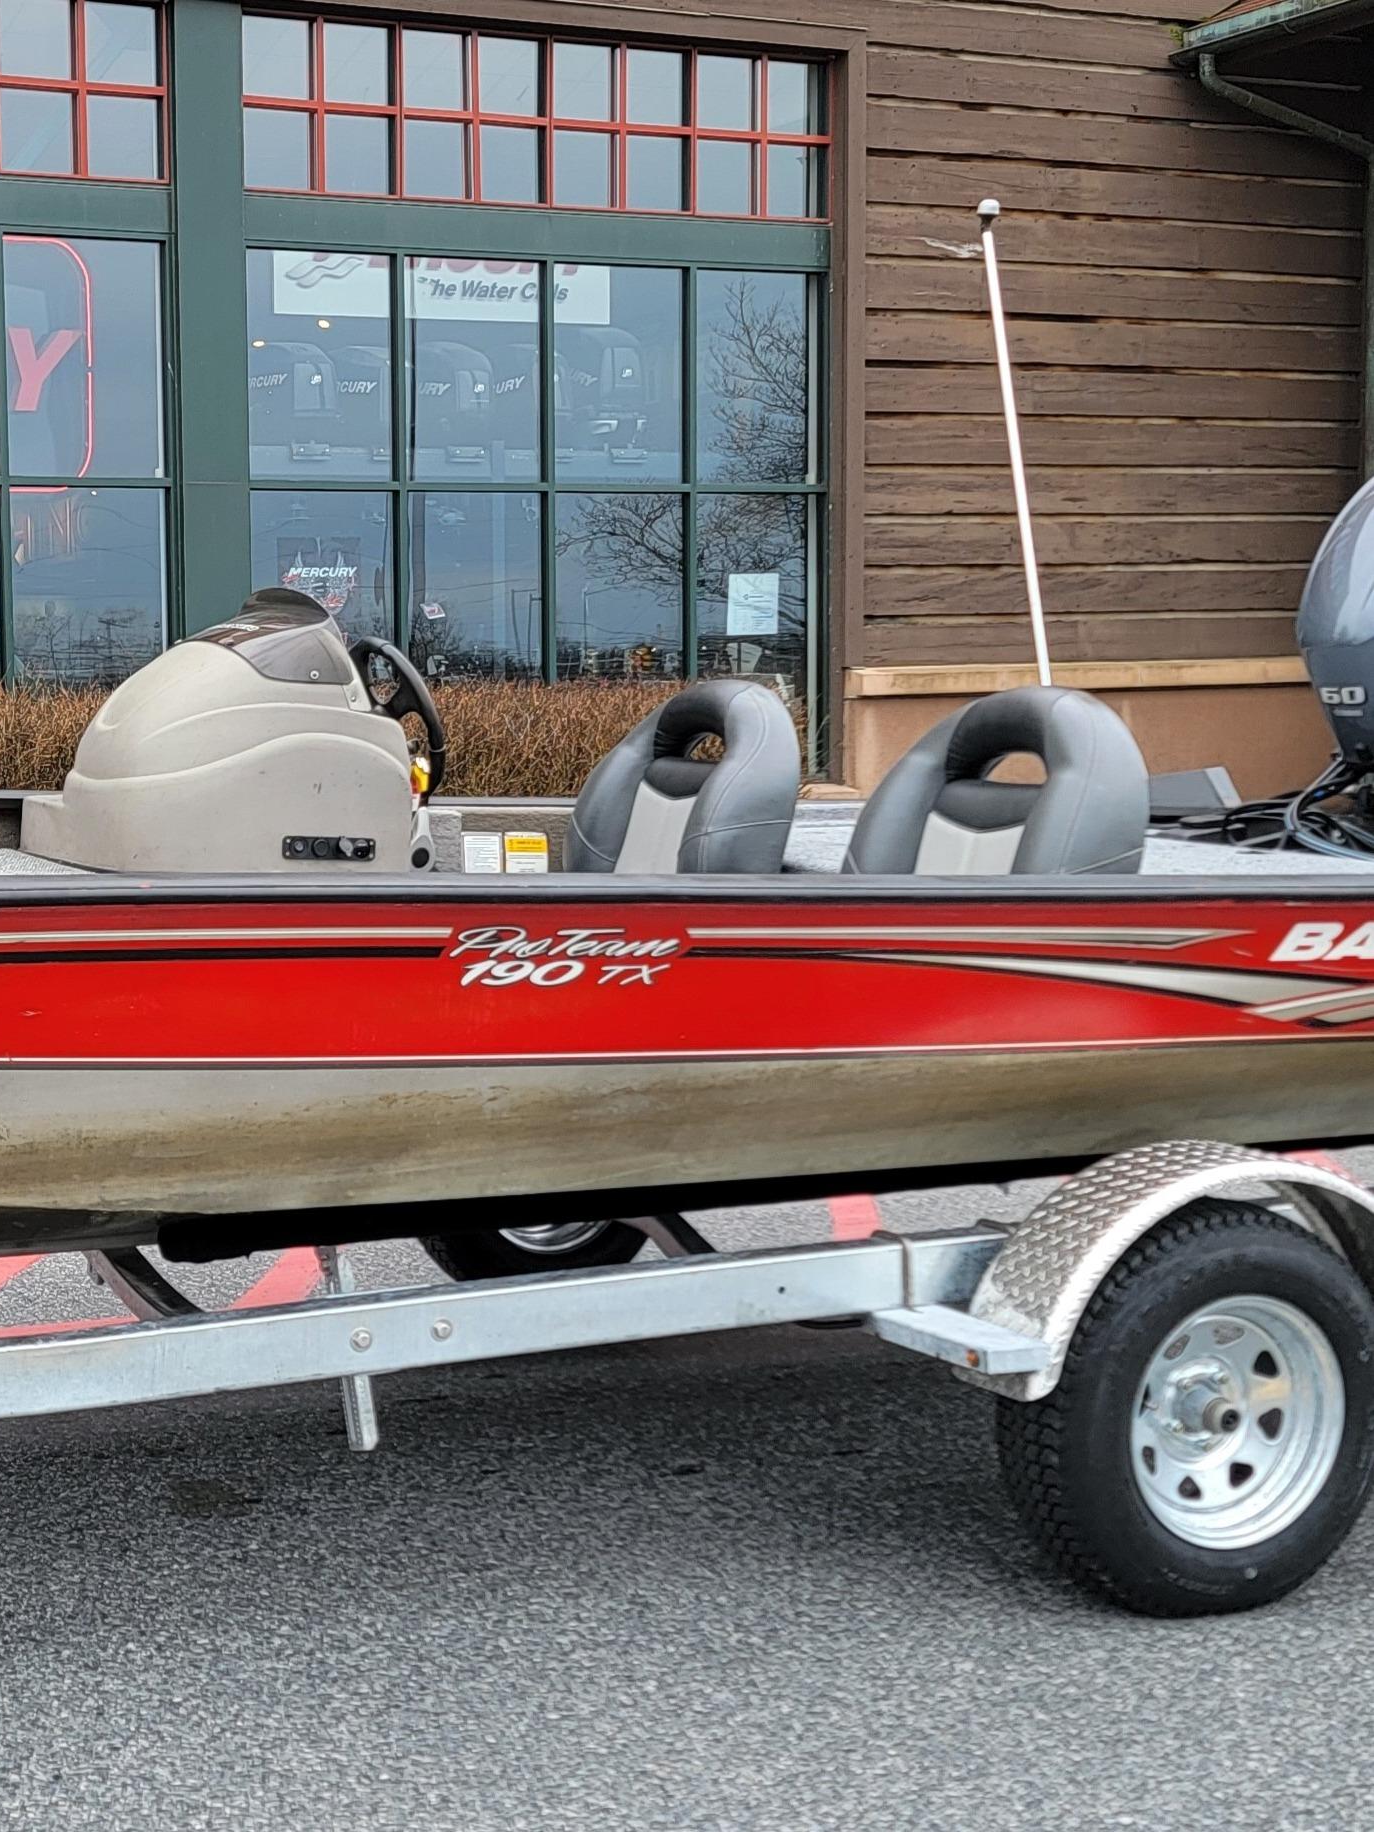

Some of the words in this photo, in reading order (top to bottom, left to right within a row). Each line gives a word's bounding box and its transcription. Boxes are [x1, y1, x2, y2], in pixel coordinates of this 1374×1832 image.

[461, 280, 518, 299] Water
[287, 566, 358, 578] MERCURY
[1319, 686, 1366, 705] 60
[460, 960, 585, 986] 190
[597, 963, 671, 985] TX
